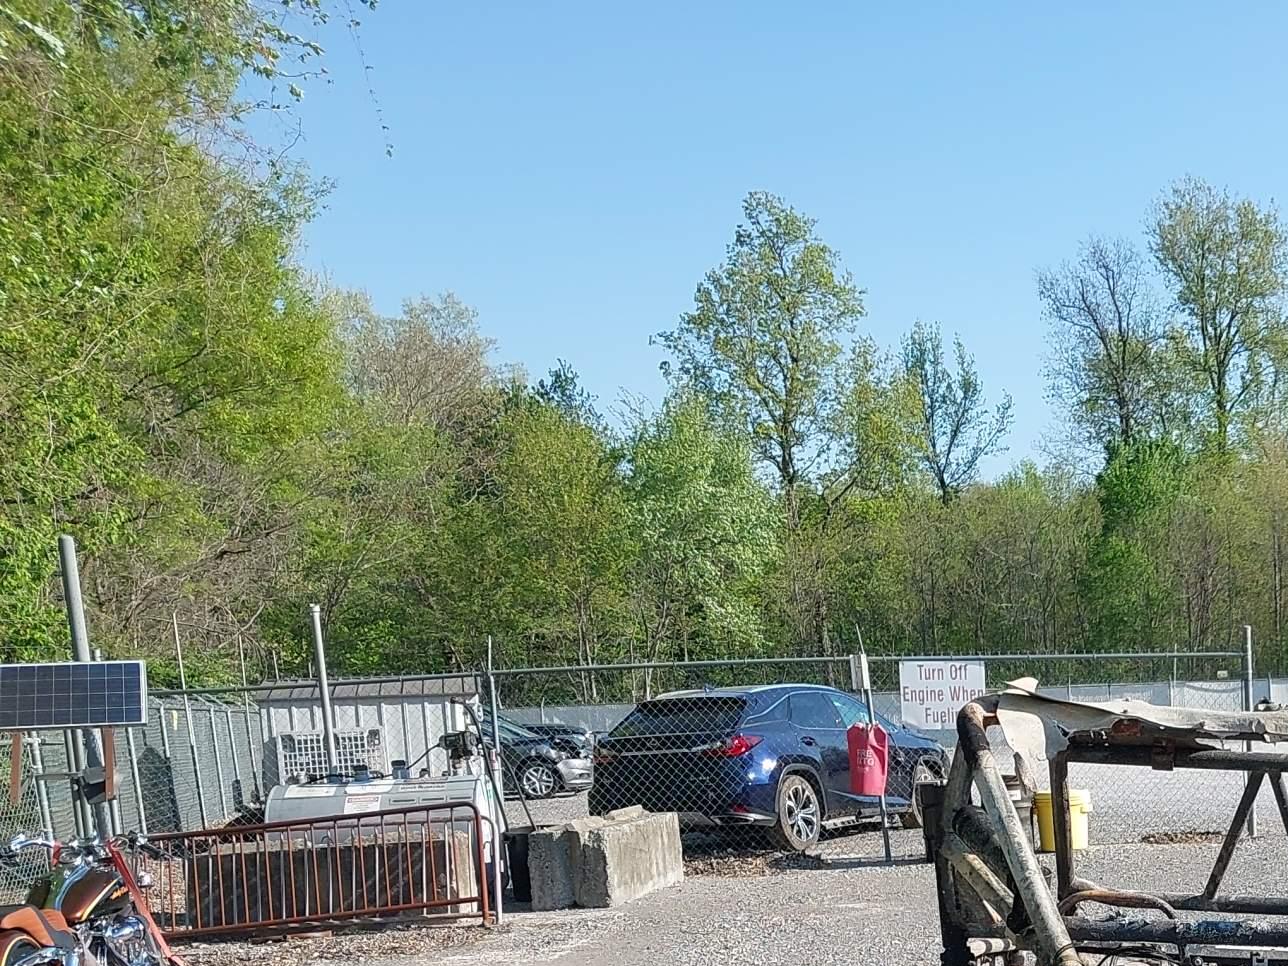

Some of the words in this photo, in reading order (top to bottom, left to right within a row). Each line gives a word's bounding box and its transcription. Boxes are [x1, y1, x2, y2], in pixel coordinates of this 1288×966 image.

[917, 664, 944, 681] Turn
[950, 664, 968, 681] Off
[903, 686, 944, 706] Engine
[949, 686, 984, 702] When
[925, 708, 959, 725] Fueli
